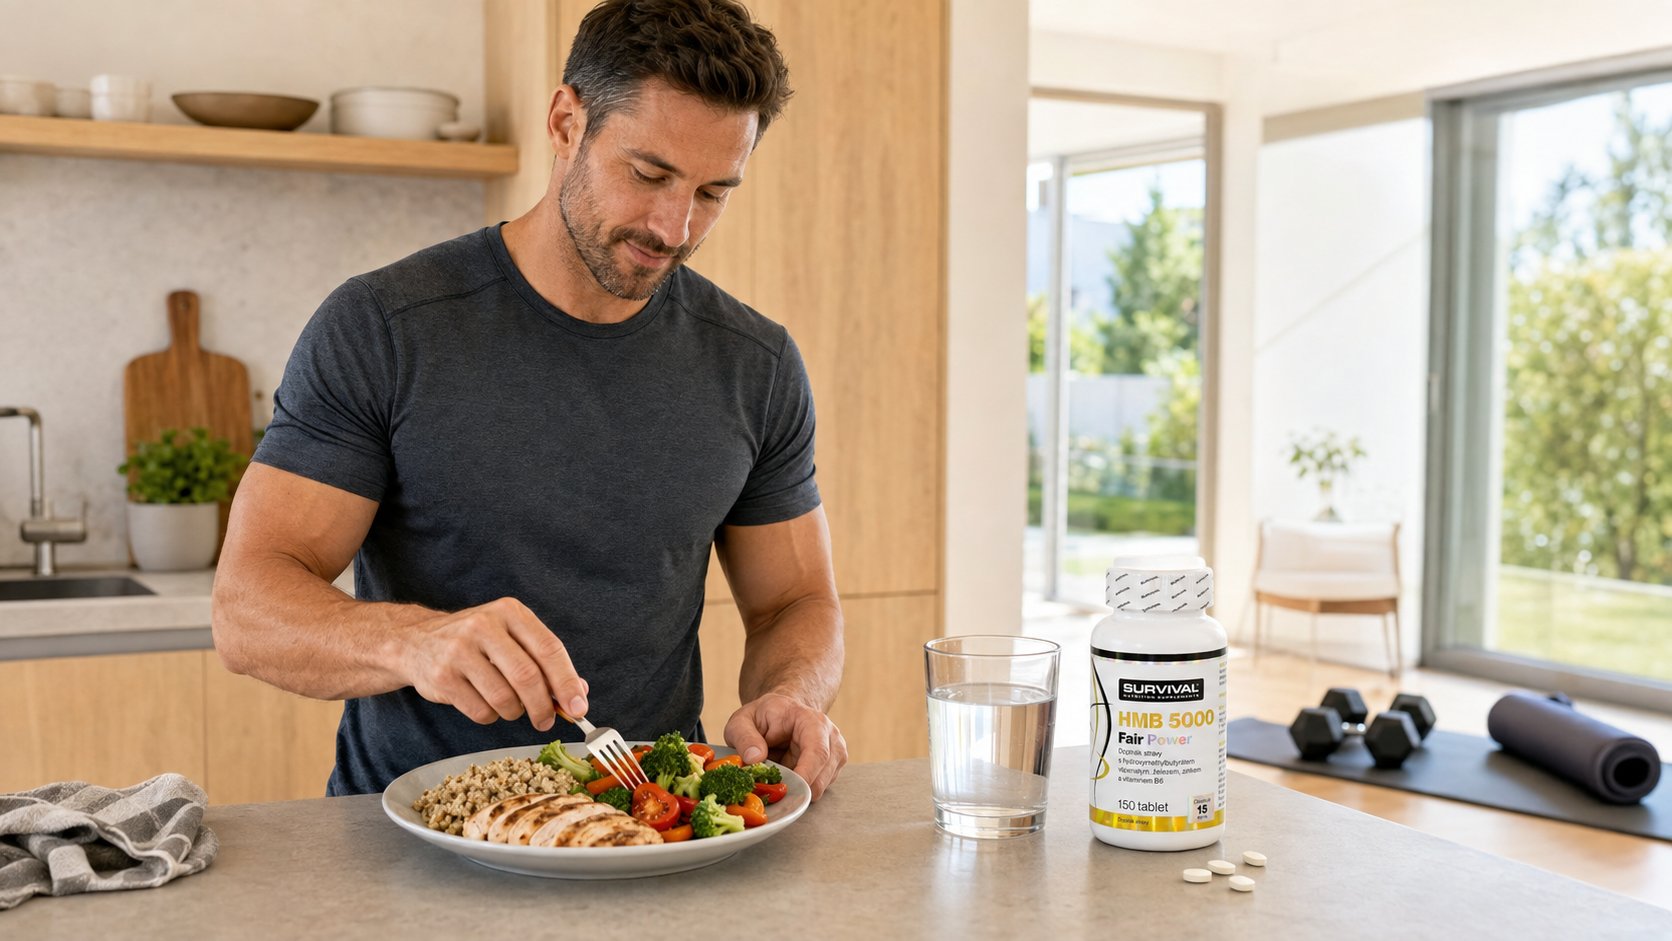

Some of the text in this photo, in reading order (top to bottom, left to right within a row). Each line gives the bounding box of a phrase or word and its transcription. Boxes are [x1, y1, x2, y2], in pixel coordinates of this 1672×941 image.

[1123, 683, 1199, 694] SURVIVAL
[1118, 711, 1163, 729] HMB
[1168, 709, 1215, 729] 5000
[1118, 732, 1193, 746] Fair Power
[1154, 777, 1165, 785] B6
[1118, 799, 1169, 812] 150 tablet
[1197, 804, 1208, 815] 15
